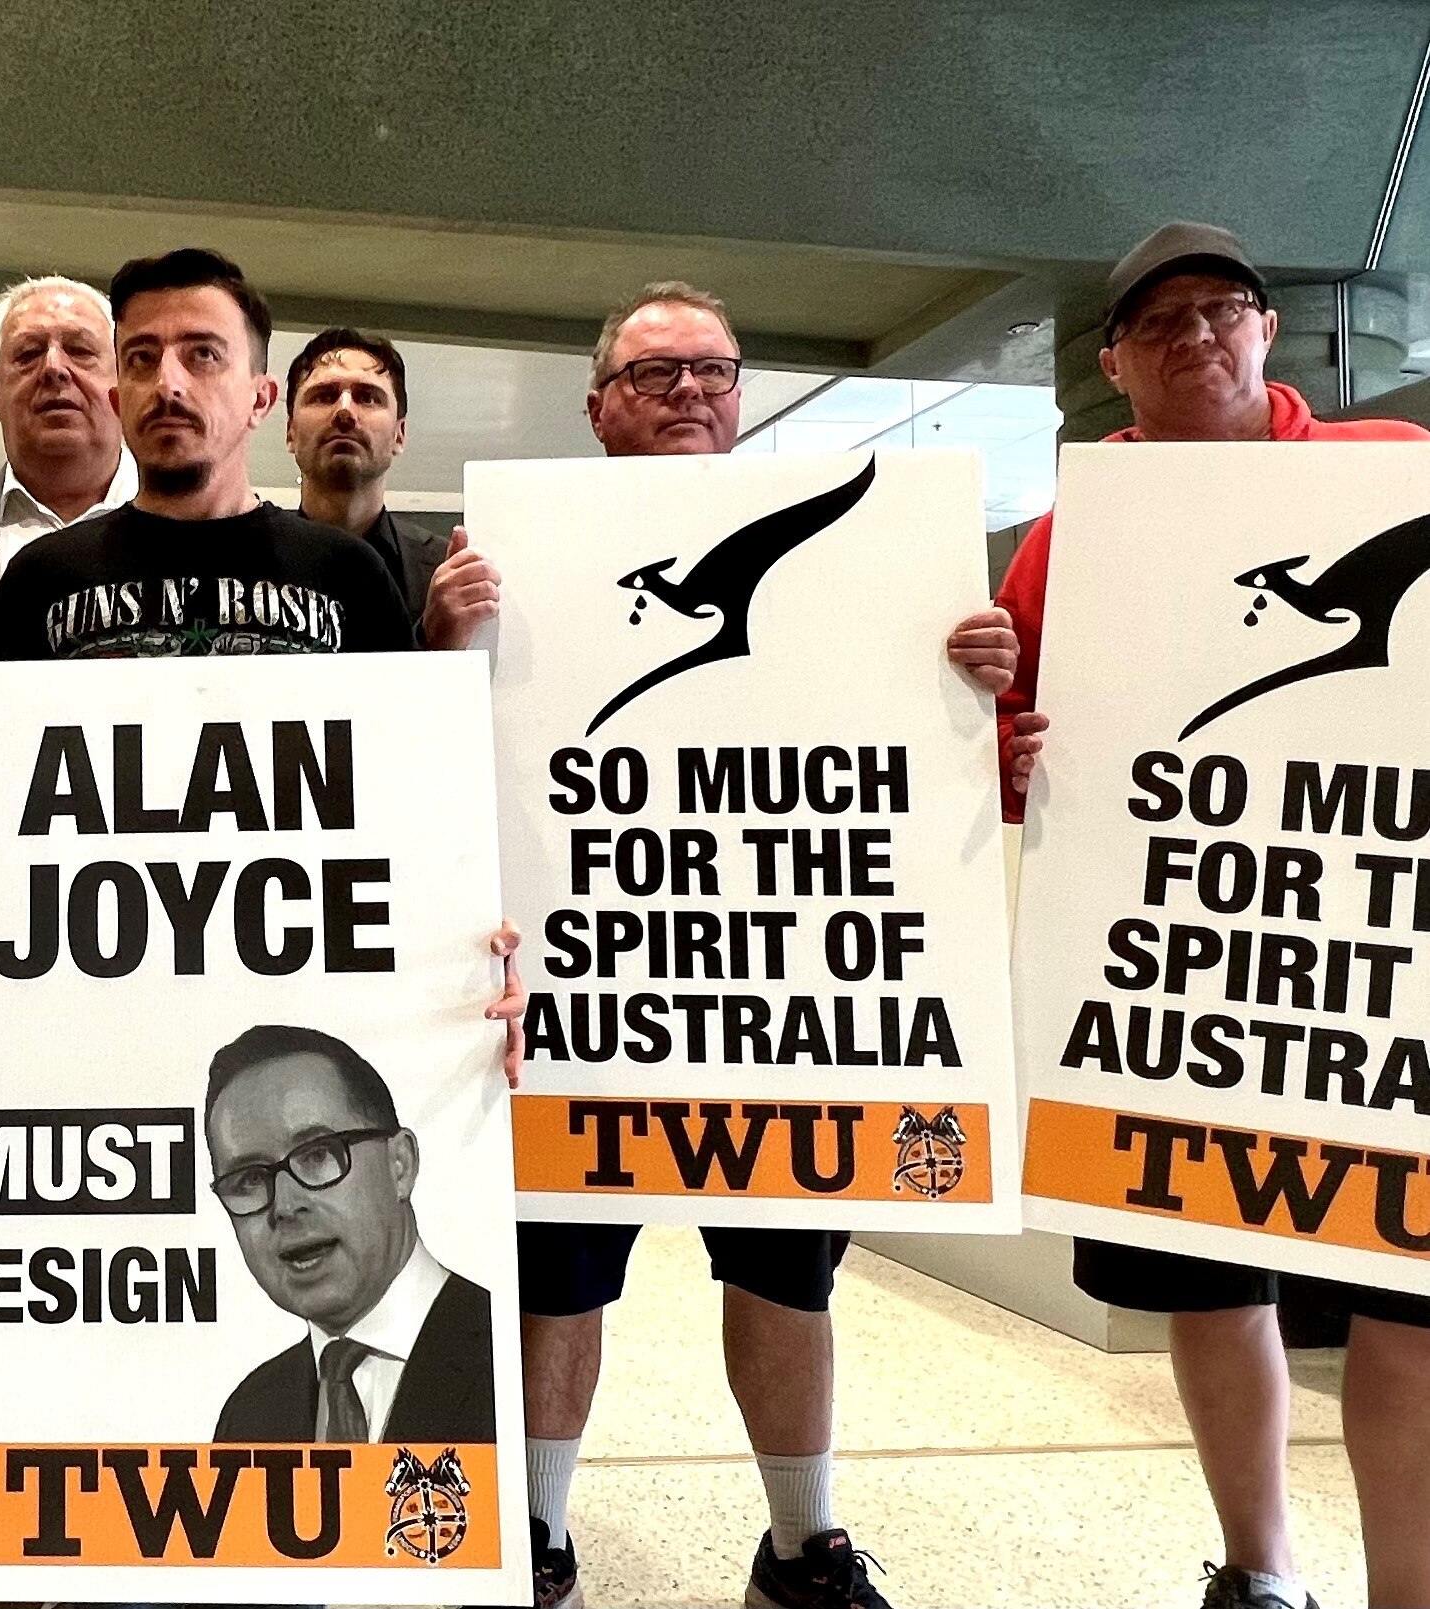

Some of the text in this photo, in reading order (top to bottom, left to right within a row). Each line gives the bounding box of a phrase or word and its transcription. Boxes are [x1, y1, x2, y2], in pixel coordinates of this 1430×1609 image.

[46, 582, 143, 652] GUNS
[218, 577, 345, 654] ROSES
[17, 719, 355, 837] ALAN
[548, 745, 910, 815] SO MUCH
[1127, 750, 1430, 842] SO MU
[570, 827, 895, 897] FOR THE
[1143, 835, 1324, 922] FOR
[543, 909, 925, 982] SPIRIT OF
[1103, 918, 1412, 1019] SPIRIT
[523, 992, 963, 1068] AUSTRALIA
[1059, 1000, 1430, 1116] AUSTRA
[568, 1099, 864, 1194] TWU
[1113, 1113, 1430, 1252] TWU
[5, 1447, 352, 1560] TWU
